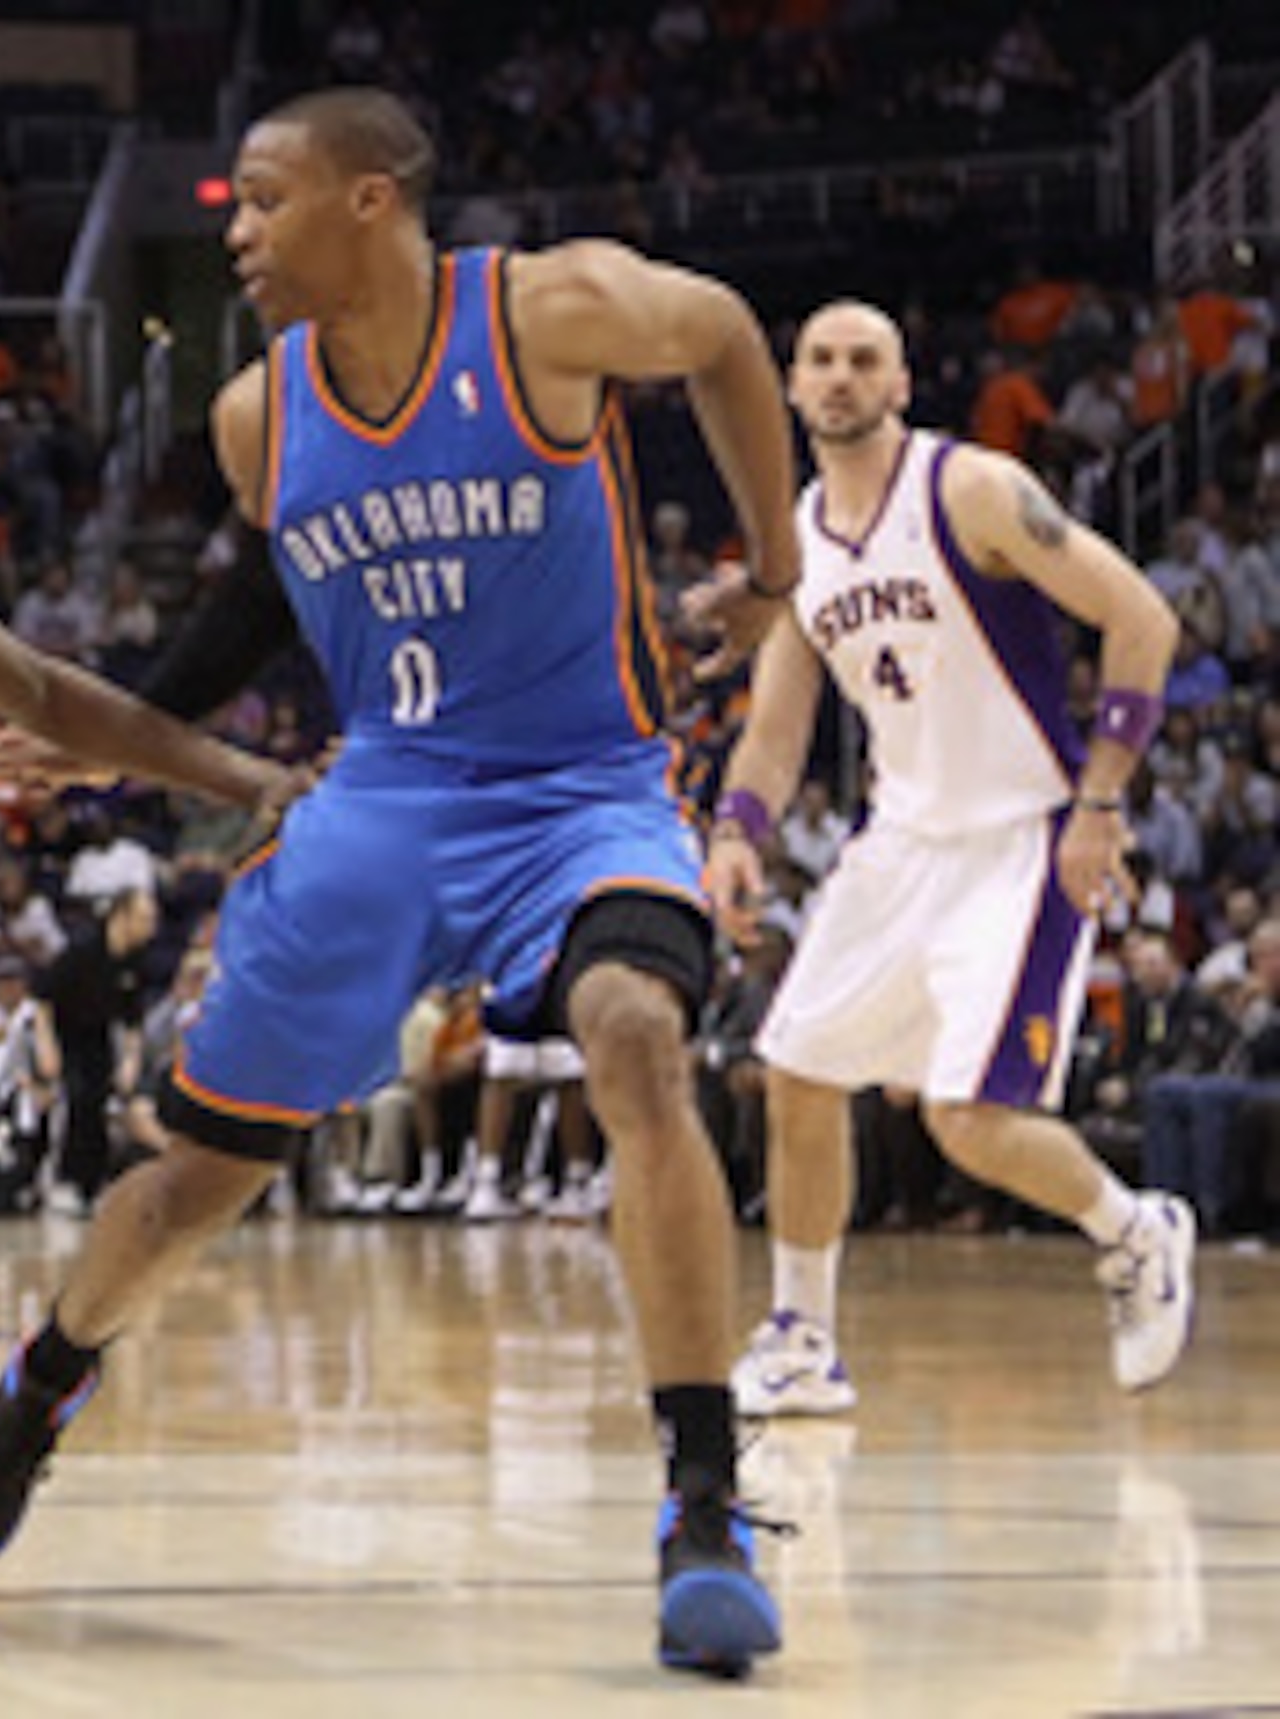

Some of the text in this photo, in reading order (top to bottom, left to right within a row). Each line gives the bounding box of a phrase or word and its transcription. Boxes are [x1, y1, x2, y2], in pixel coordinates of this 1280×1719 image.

[281, 474, 545, 581] OKLAHOMA
[363, 558, 467, 620] CITY
[814, 577, 937, 649] SUNS
[390, 636, 440, 726] 0
[873, 645, 915, 702] 4
